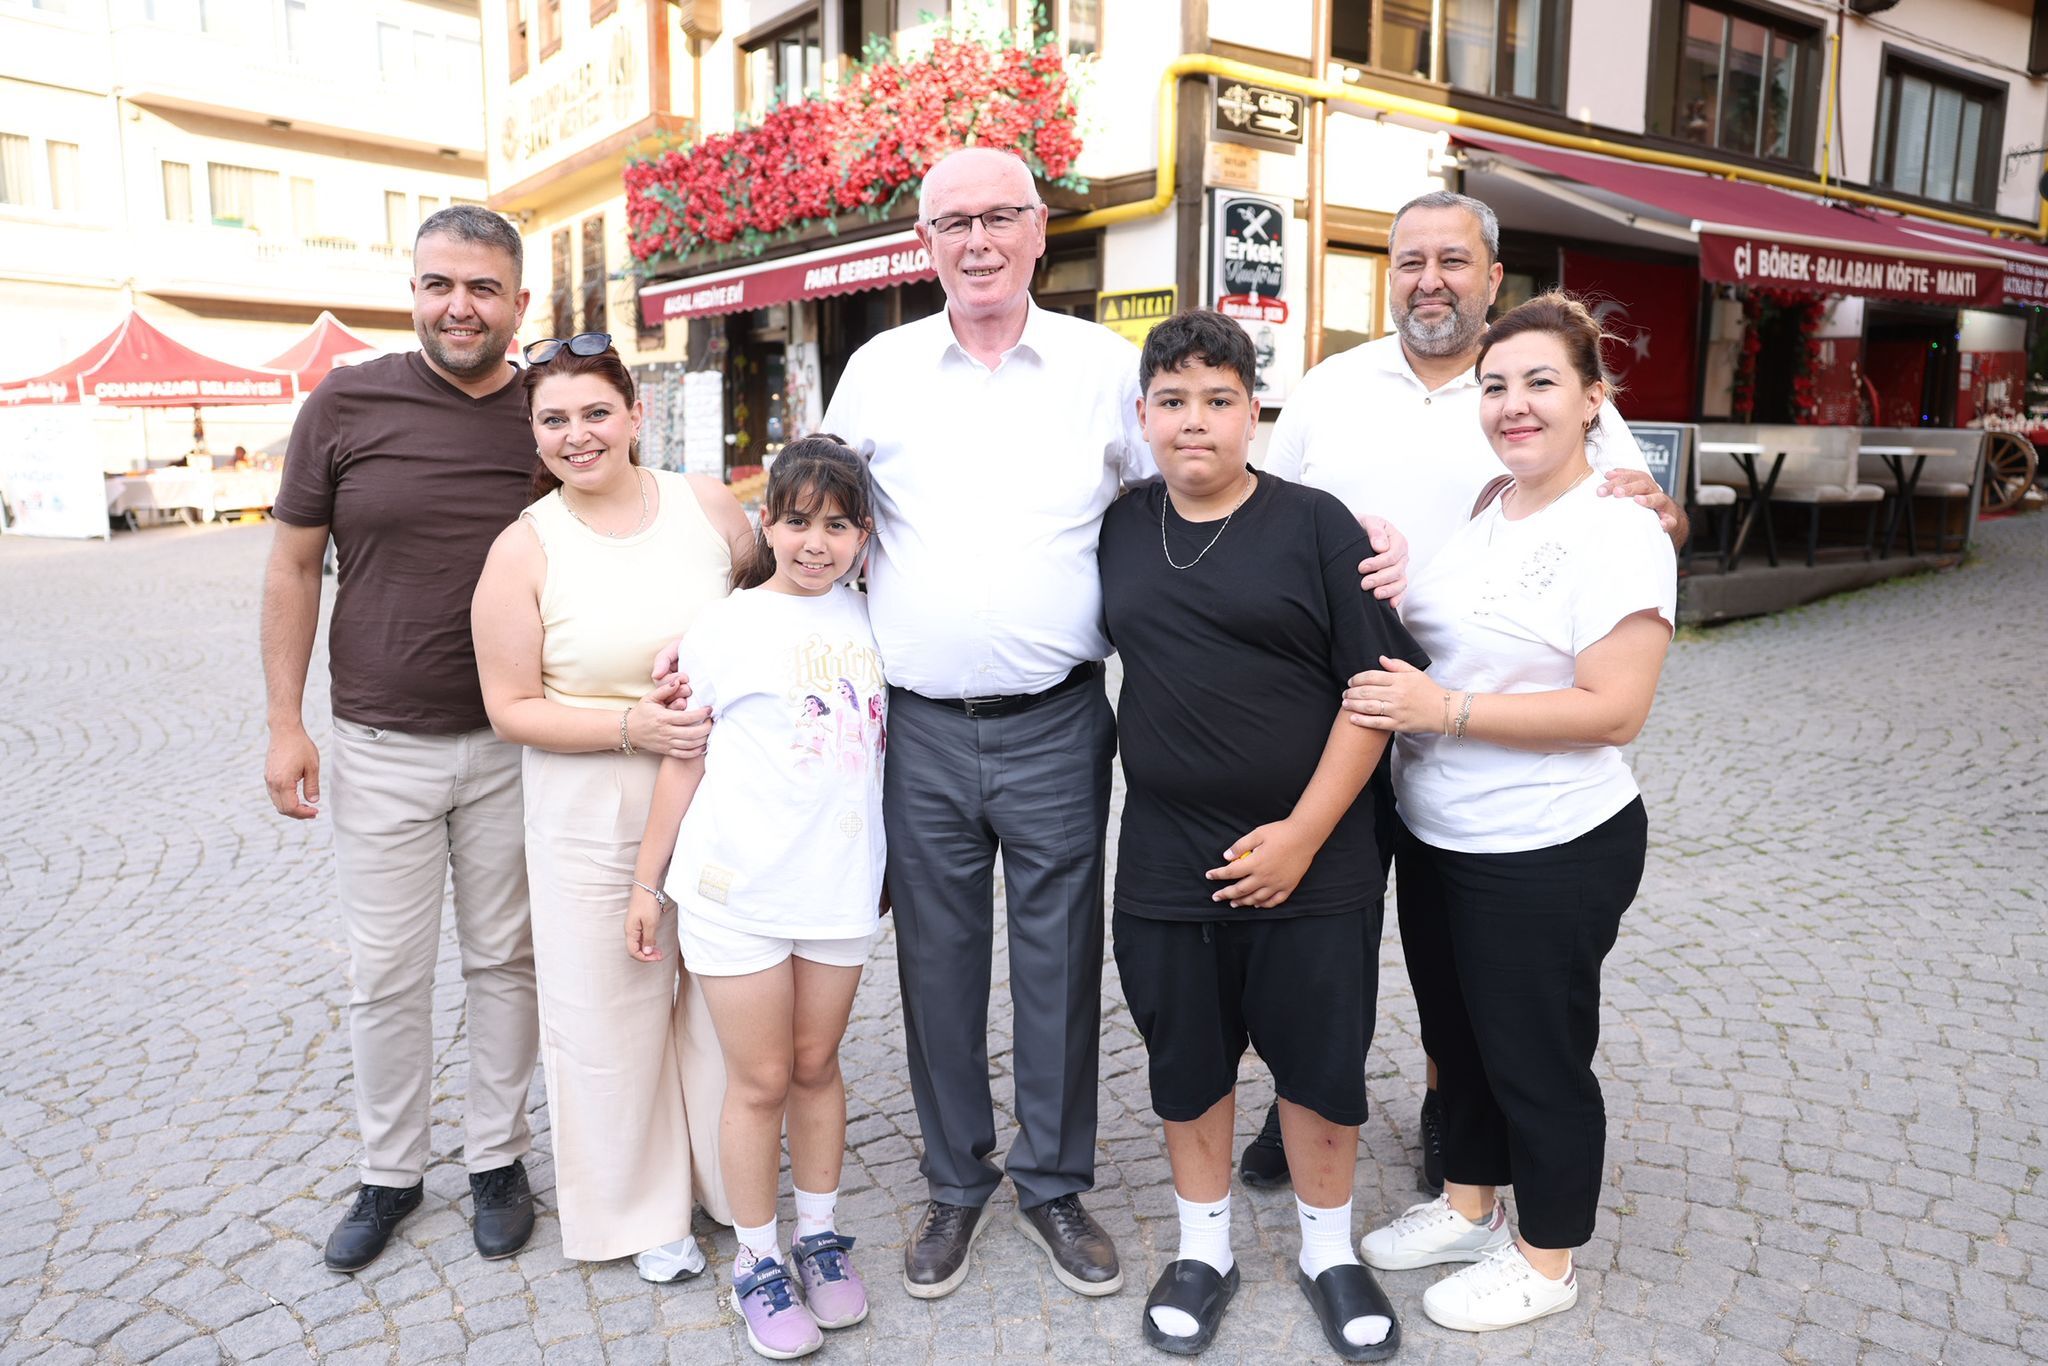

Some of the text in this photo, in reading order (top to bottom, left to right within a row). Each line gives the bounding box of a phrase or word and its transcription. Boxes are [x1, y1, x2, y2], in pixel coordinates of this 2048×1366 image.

[1225, 236, 1283, 264] Erkek
[803, 248, 930, 290] PARK BERBER SALO
[1886, 262, 1929, 294] KÖFTE
[1121, 295, 1172, 319] DİKKAT
[757, 1267, 782, 1281] kinetix
